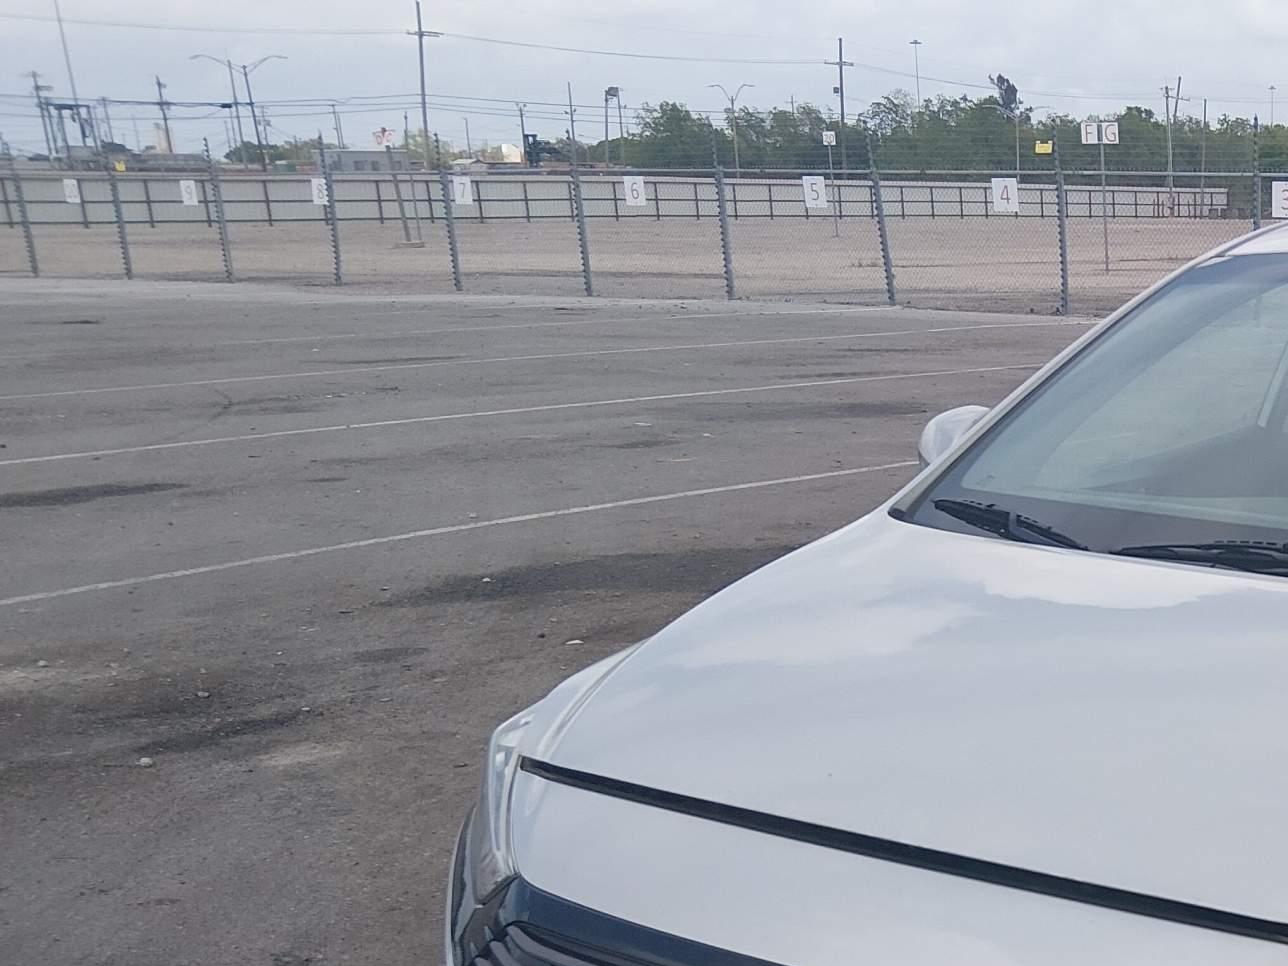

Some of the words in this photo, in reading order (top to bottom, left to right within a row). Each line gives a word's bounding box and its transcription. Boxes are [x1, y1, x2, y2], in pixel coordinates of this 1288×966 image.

[1084, 124, 1094, 143] F
[1104, 124, 1118, 143] G
[459, 182, 467, 199] 7
[630, 181, 640, 200] 6
[810, 182, 820, 201] 5
[1000, 185, 1011, 204] 4
